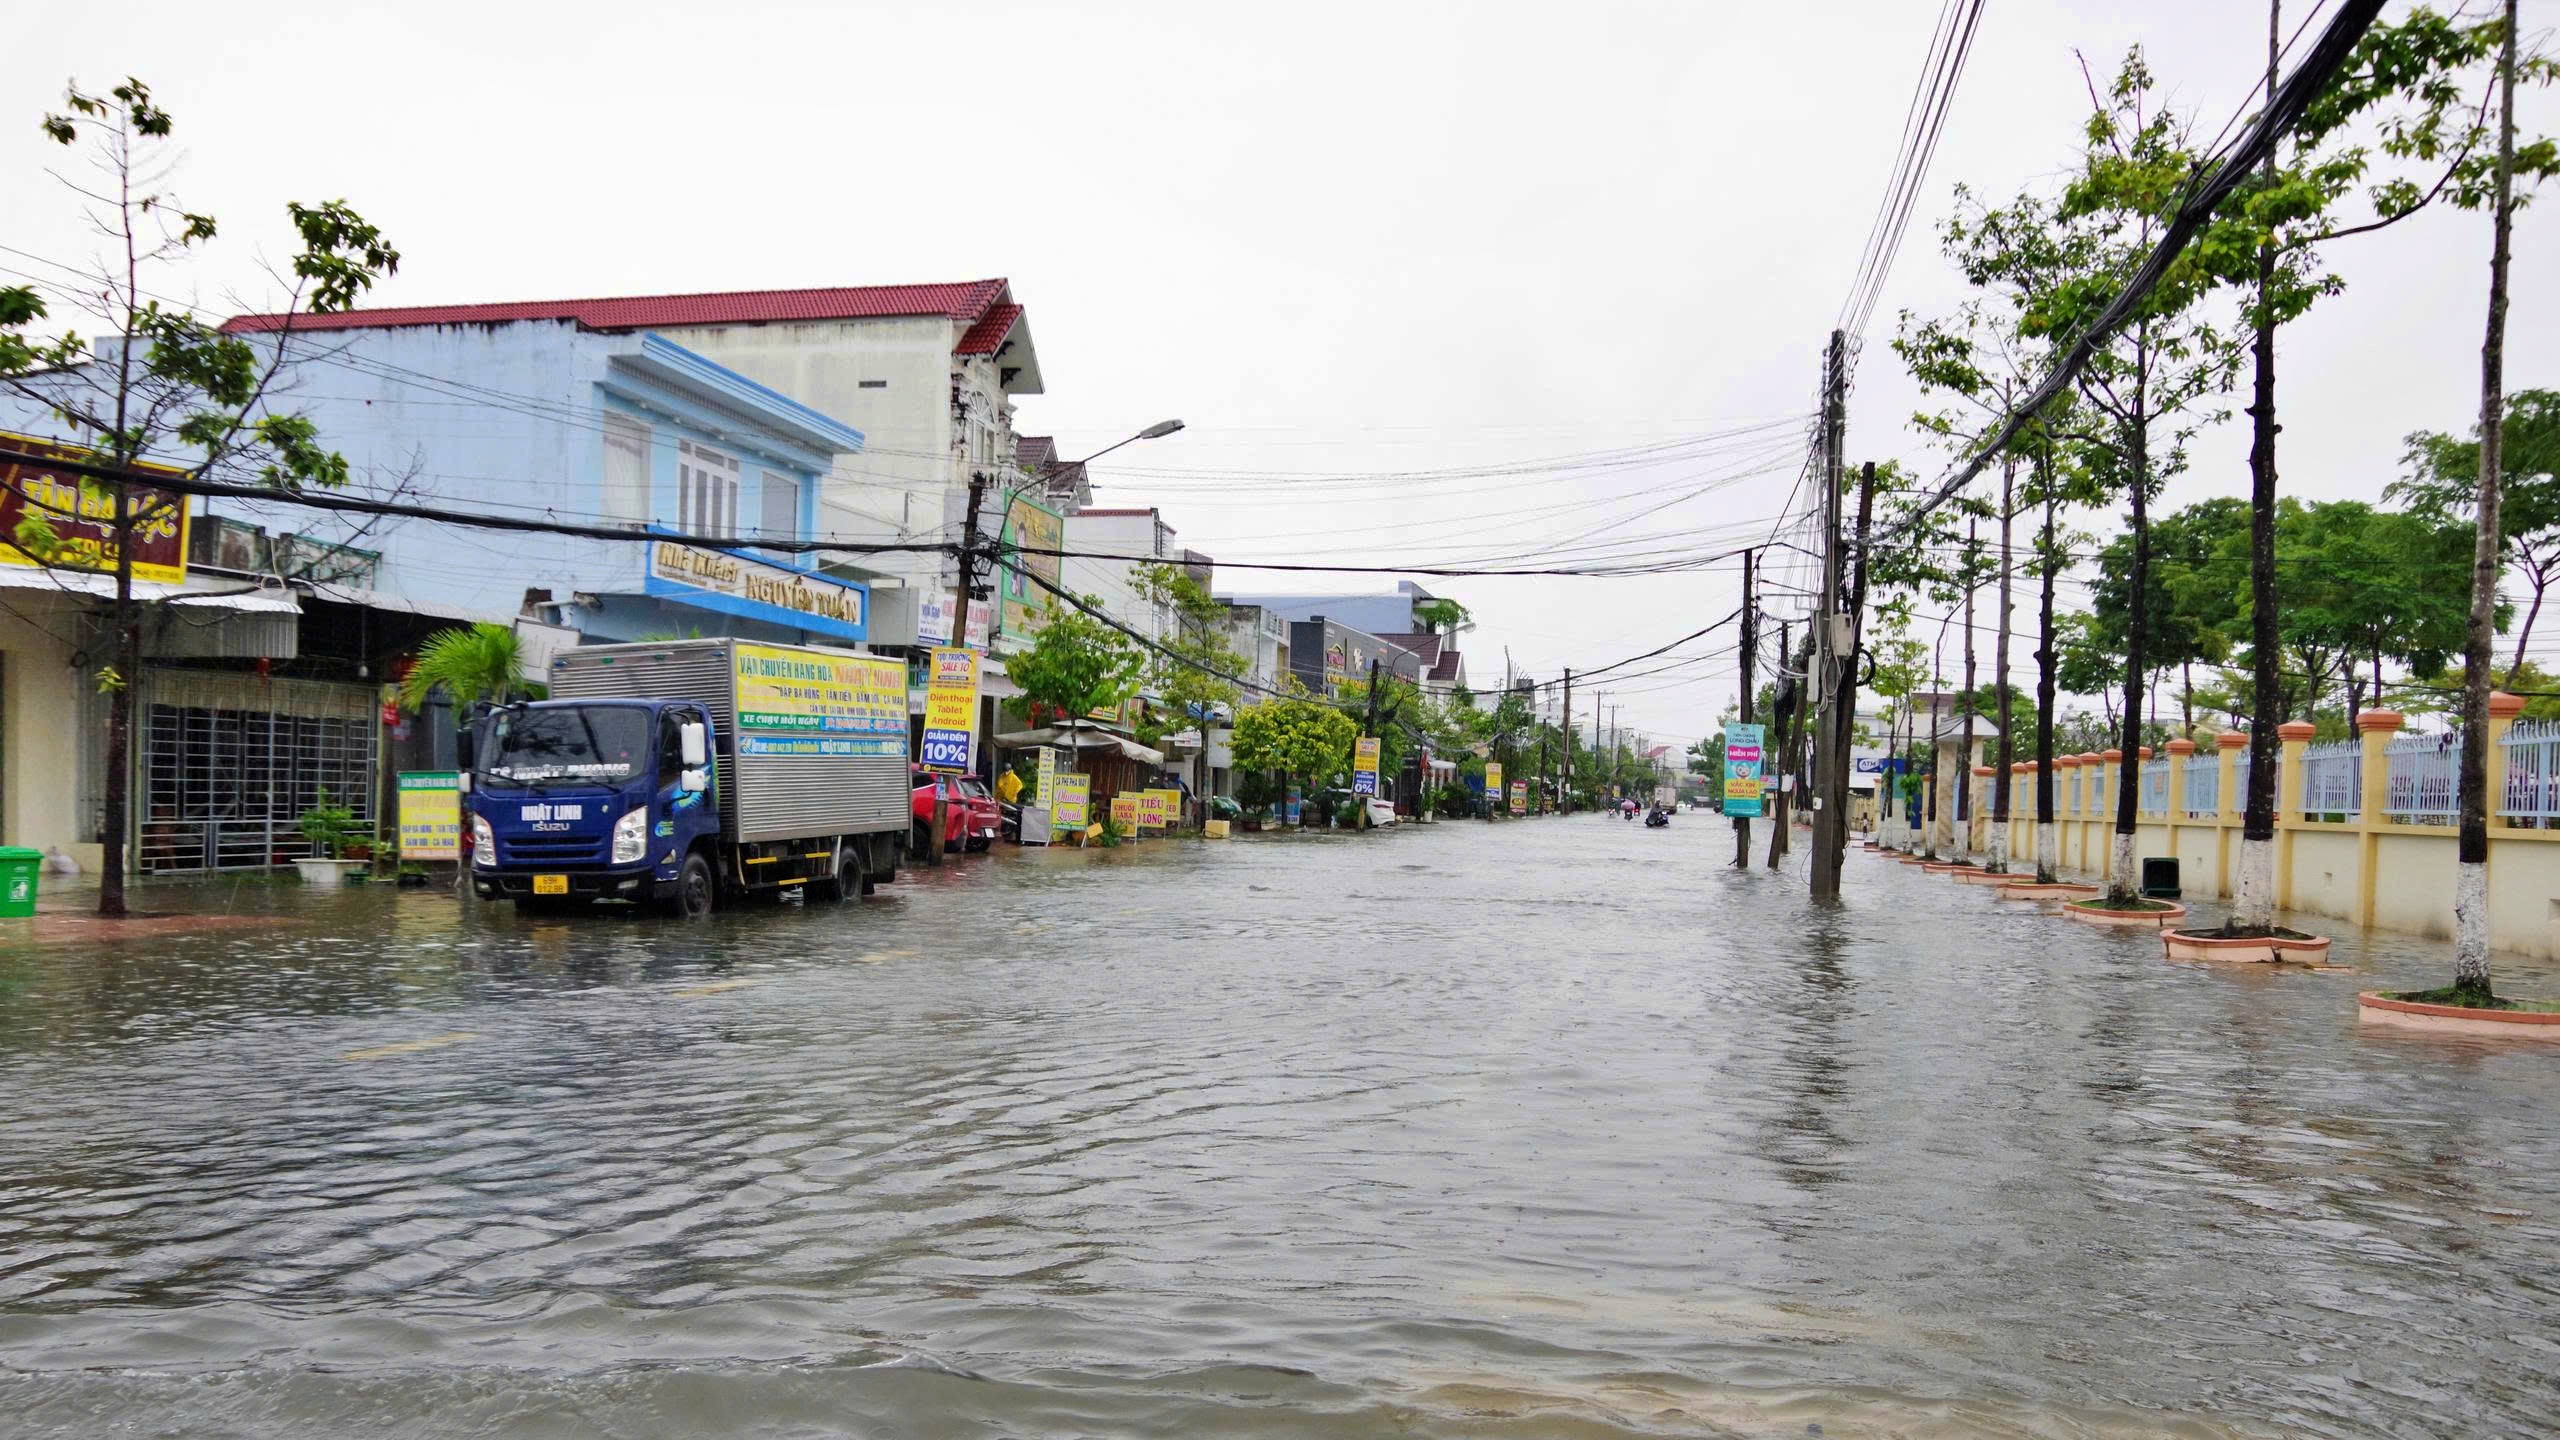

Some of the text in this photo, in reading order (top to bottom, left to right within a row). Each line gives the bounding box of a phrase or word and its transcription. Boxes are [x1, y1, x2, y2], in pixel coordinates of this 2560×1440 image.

[740, 654, 758, 678] VẬN
[760, 656, 792, 679] CHUYỂN
[941, 661, 970, 673] SALE TO
[930, 692, 973, 705] Điện thoại
[937, 704, 963, 714] Tablet
[743, 714, 755, 723] XE
[756, 715, 780, 726] CHẠY
[931, 716, 966, 726] Android
[927, 731, 967, 742] GIẢM ĐẾN
[925, 743, 967, 762] 10%
[1729, 748, 1759, 757] MIỄN PHÍ
[1862, 760, 1876, 768] ATM
[1354, 783, 1373, 794] 0%
[521, 803, 582, 822] NHẬT LINH
[532, 822, 570, 832] ISUZU
